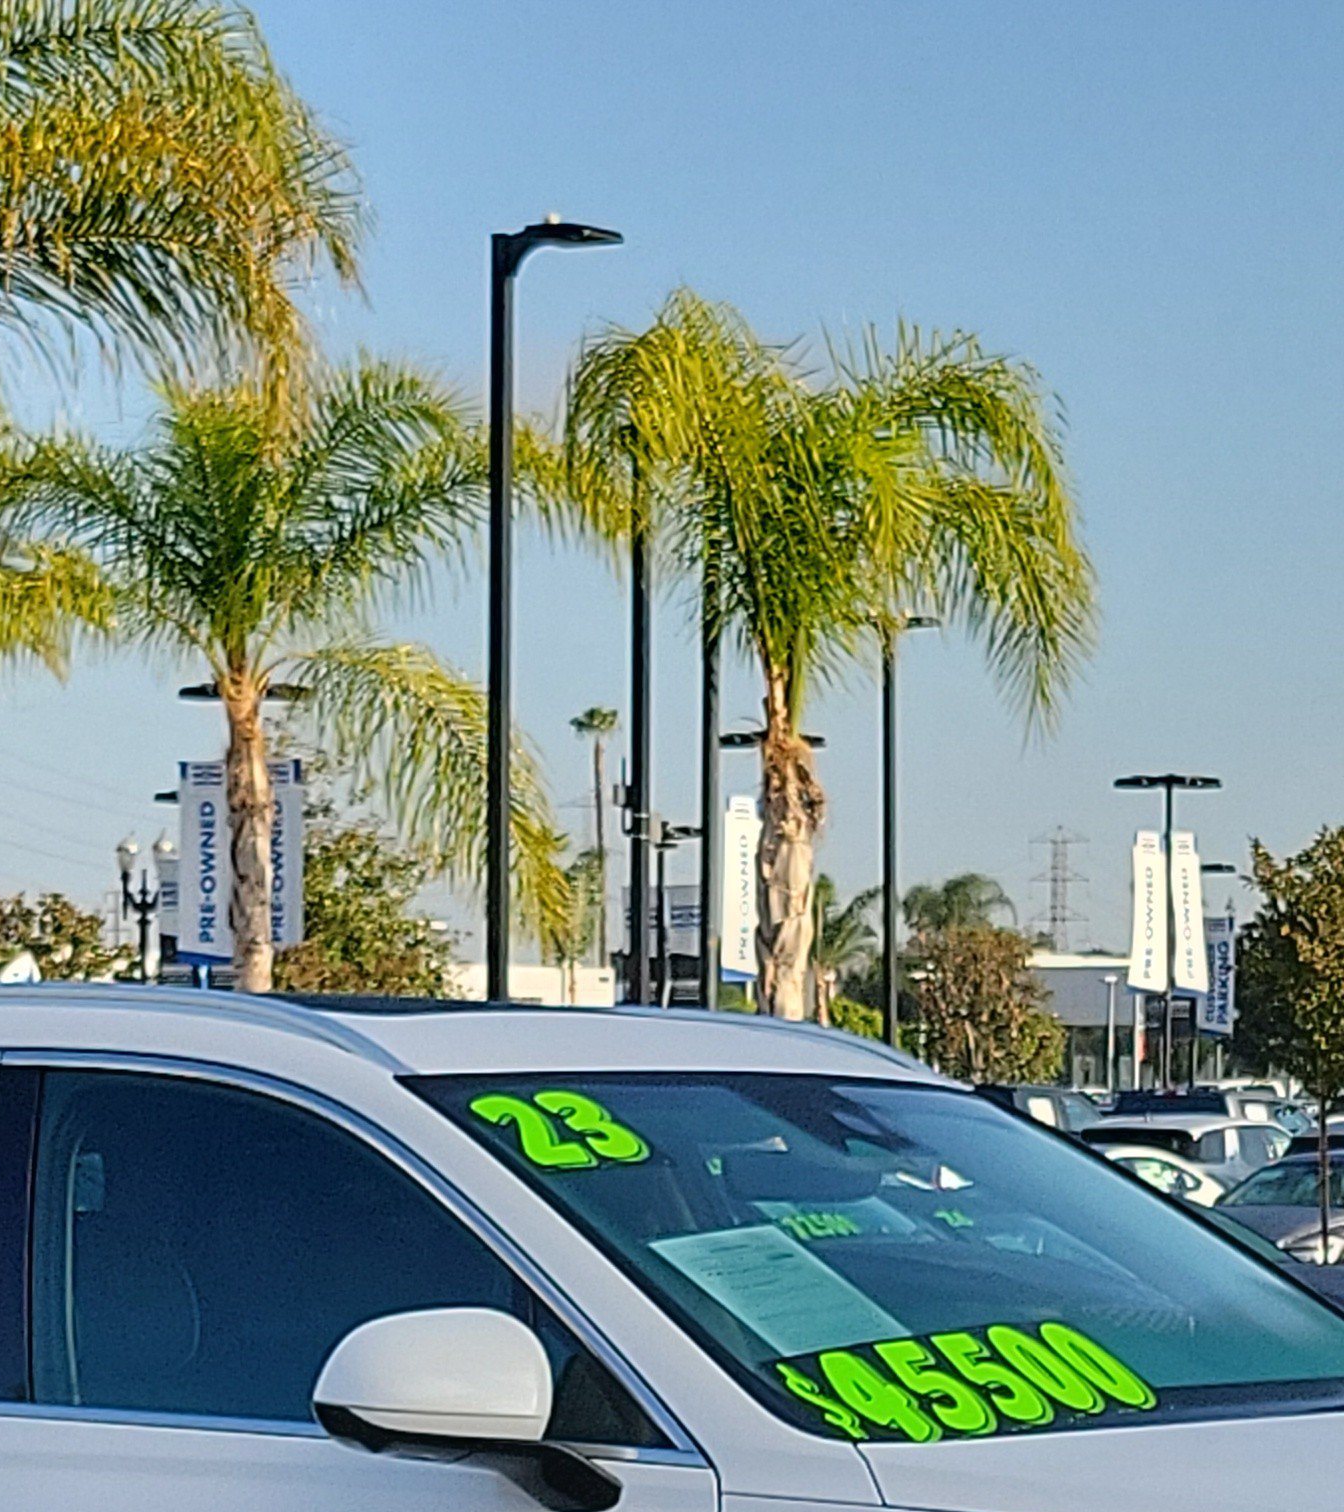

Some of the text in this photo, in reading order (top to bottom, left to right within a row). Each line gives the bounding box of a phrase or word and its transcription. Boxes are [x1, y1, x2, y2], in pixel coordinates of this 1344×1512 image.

[199, 800, 217, 944] PRE-OWNED
[1216, 941, 1230, 1026] PARKING
[469, 1091, 651, 1170] 23
[775, 1321, 1157, 1444] $45500
